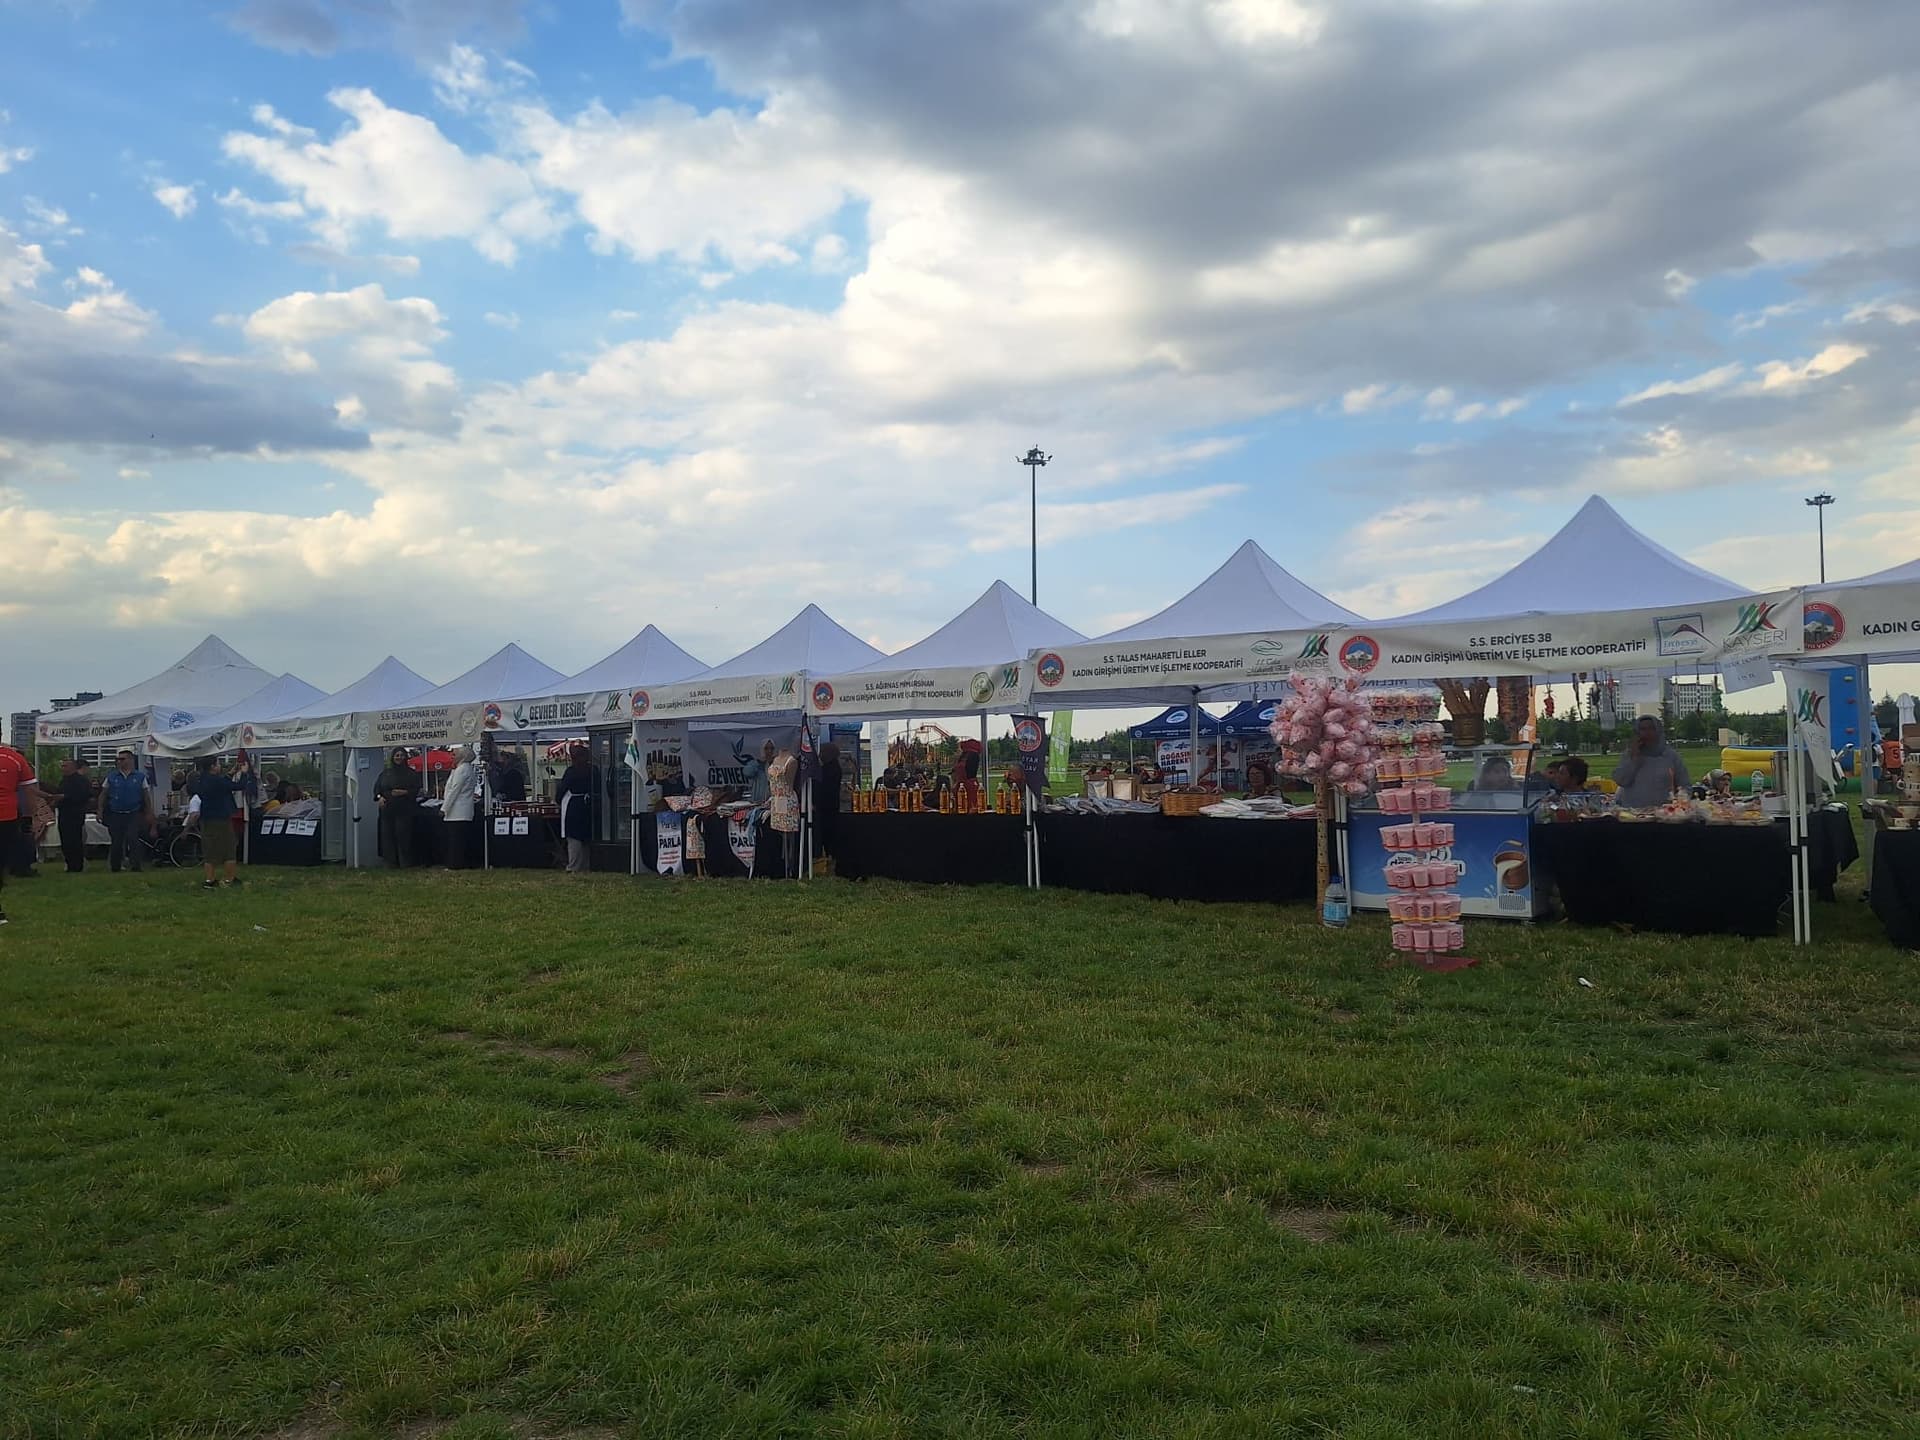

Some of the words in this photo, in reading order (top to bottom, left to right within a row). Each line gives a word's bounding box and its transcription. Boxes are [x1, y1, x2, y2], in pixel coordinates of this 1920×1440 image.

[1863, 622, 1907, 636] KADIN
[1469, 637, 1488, 647] S.S.
[1490, 633, 1535, 646] ERCİYES
[1537, 633, 1552, 643] 38
[1722, 629, 1788, 650] KAYSERİ
[1103, 656, 1116, 665] S.S.
[1117, 654, 1139, 664] TALAS
[1140, 649, 1182, 662] MAHARETLİ
[1184, 650, 1207, 659] ELLER
[1391, 654, 1422, 664] KADIN
[1424, 651, 1464, 665] GİRİŞİMİ
[1465, 648, 1503, 661] ÜRETİM
[1505, 650, 1519, 660] VE
[1522, 647, 1567, 661] İŞLETME
[1570, 638, 1646, 656] KOOPERATİFİ
[1072, 668, 1093, 677] KADIN
[1094, 665, 1121, 678] GİRİŞİMİ
[1123, 664, 1149, 674] ÜRETİM
[1150, 665, 1160, 673] VE
[1160, 663, 1191, 674] İŞLETME
[1192, 658, 1243, 671] KOOPERATİFİ
[1294, 658, 1328, 669] KAYSE
[839, 694, 856, 703] KADIN
[927, 688, 964, 699] KOOPERATİFİ
[529, 704, 558, 721] GEVHER
[559, 701, 587, 718] NESİBE
[659, 837, 682, 849] PARLA
[730, 836, 755, 848] PARL
